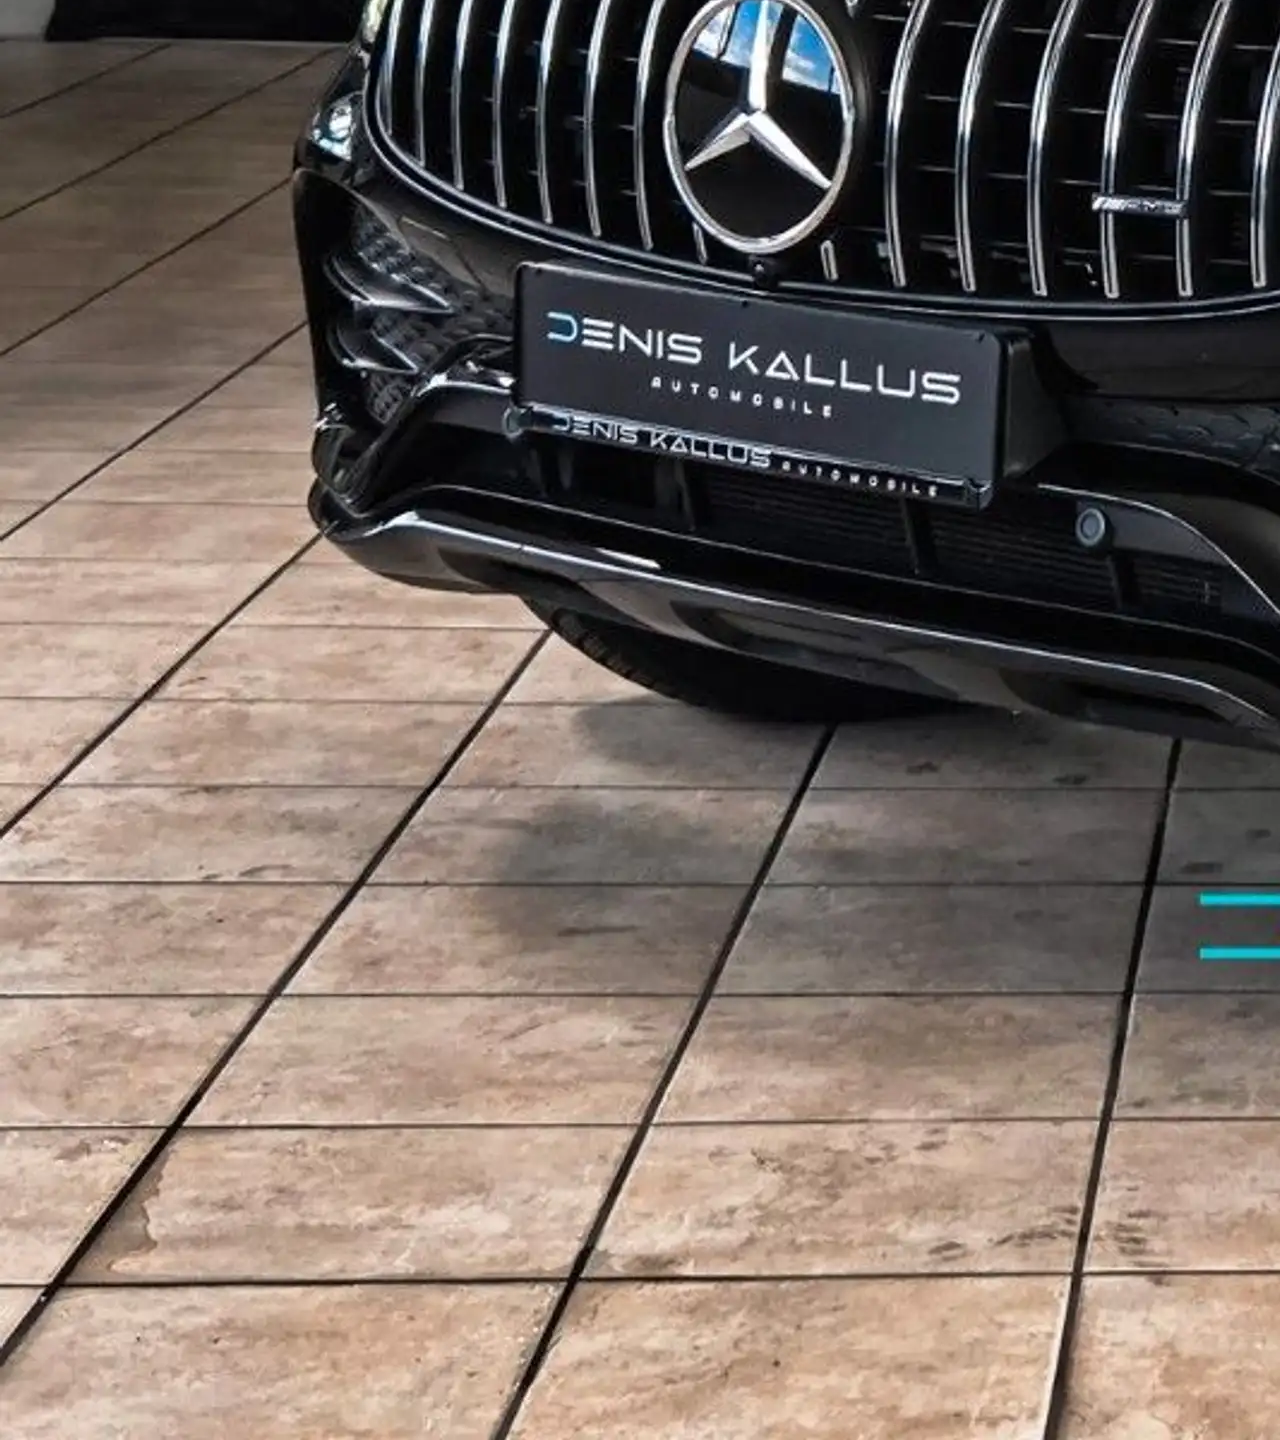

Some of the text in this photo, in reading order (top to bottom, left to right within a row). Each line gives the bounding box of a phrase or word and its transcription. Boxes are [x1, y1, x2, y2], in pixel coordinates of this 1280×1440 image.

[546, 311, 962, 405] DENIS KALLUS
[650, 376, 833, 418] AUTOMOBILE
[552, 413, 939, 498] DENIS KALLUS AUTOMOBILE
